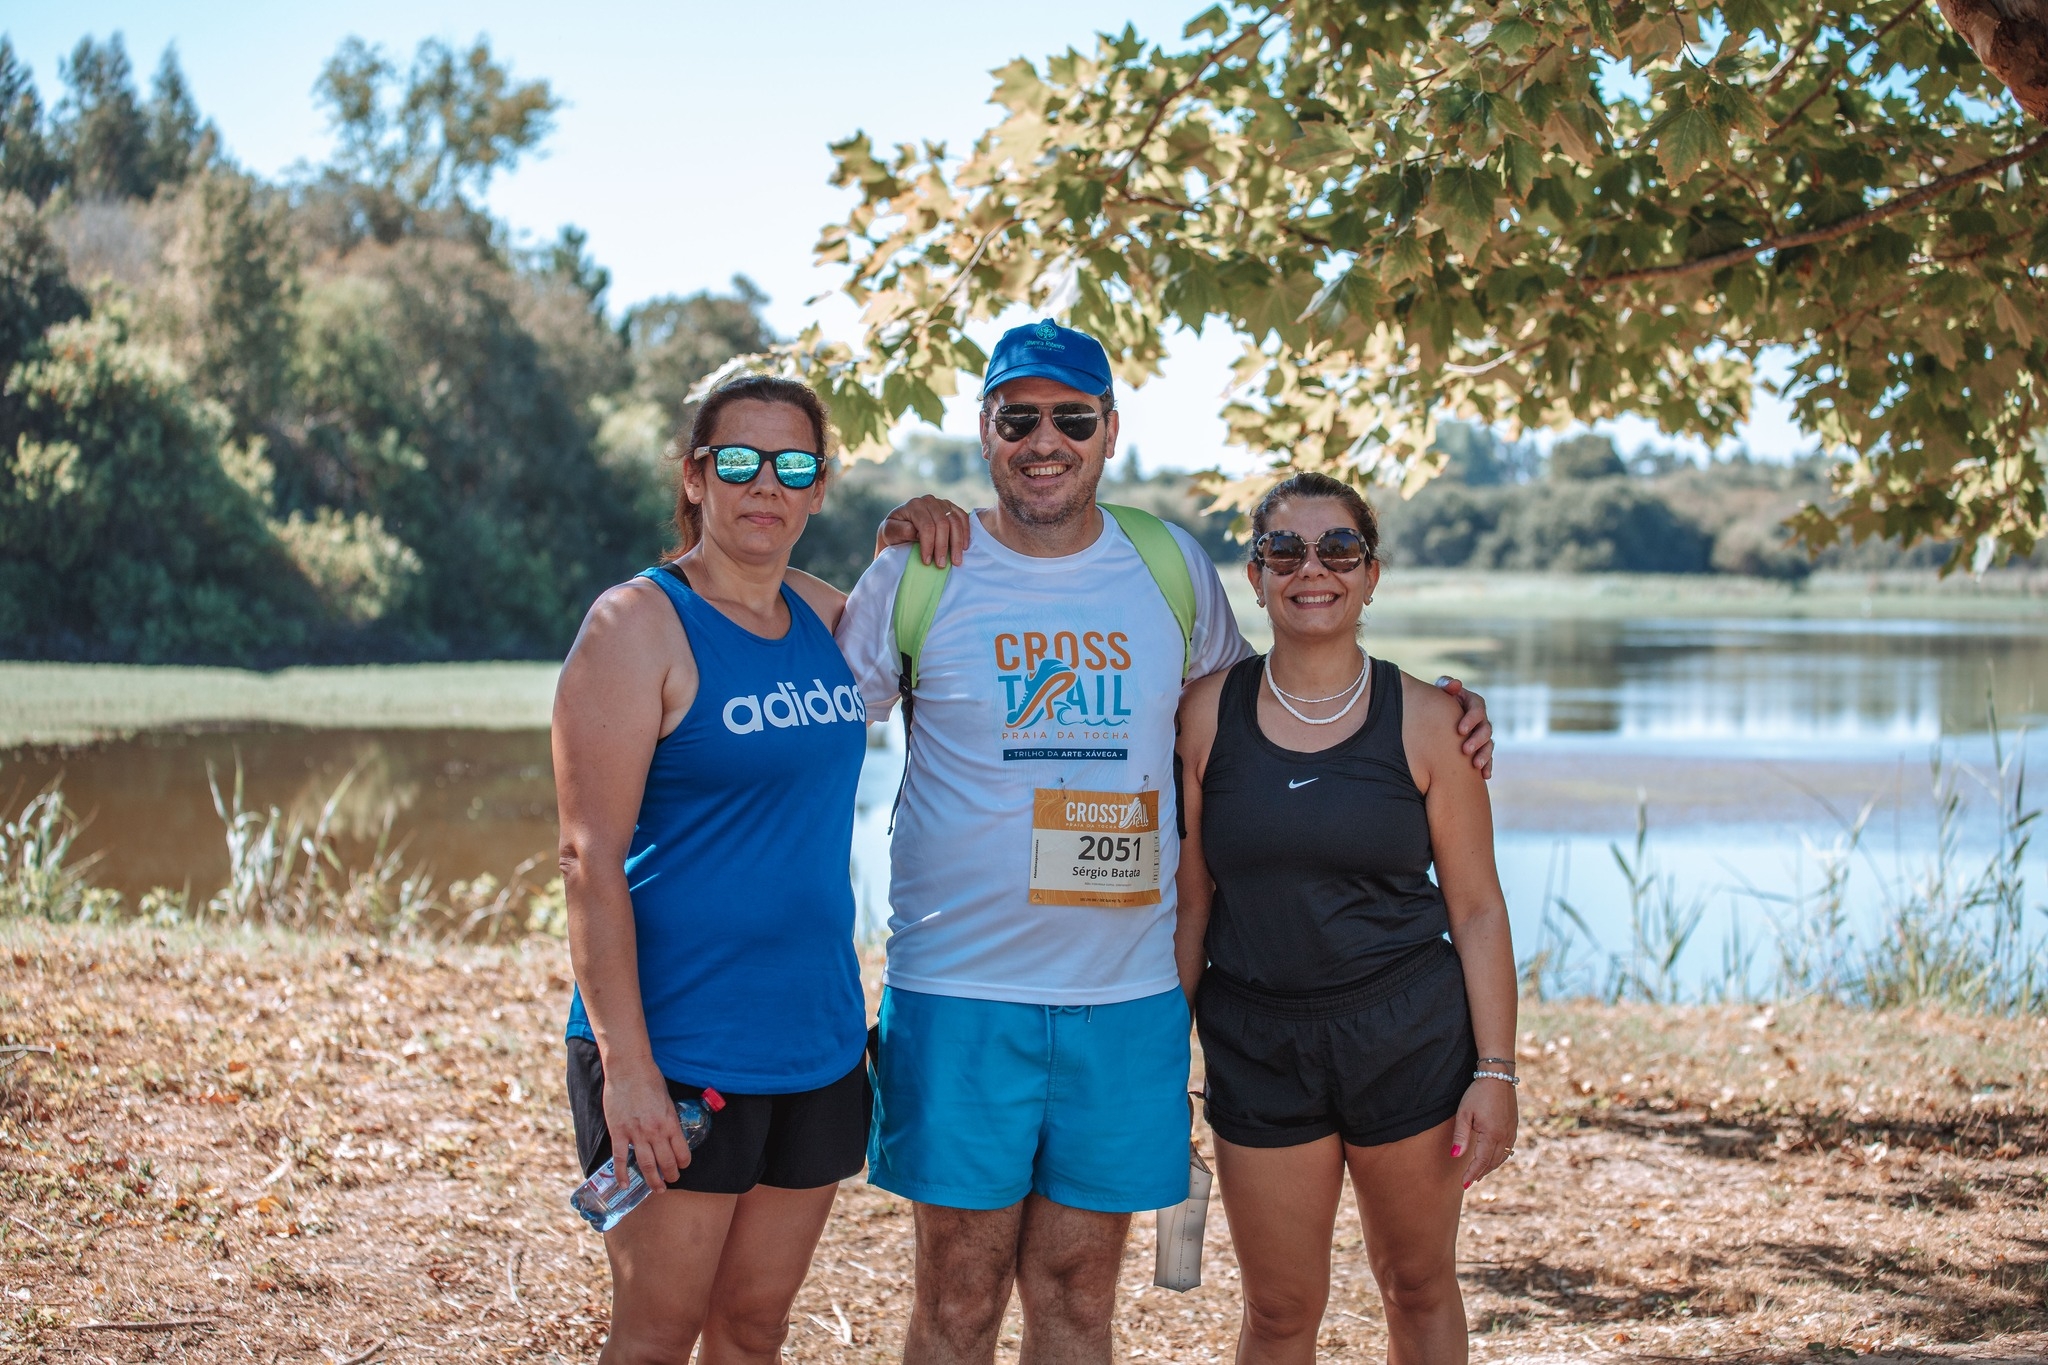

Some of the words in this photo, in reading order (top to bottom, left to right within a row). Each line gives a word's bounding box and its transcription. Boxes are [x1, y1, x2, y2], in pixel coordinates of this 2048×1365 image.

[994, 631, 1132, 671] CROSS
[722, 678, 866, 735] adidas
[1002, 731, 1047, 740] PRAIA
[1057, 731, 1075, 739] DA
[1083, 731, 1129, 740] TOCHA
[1014, 750, 1045, 758] TRILHO
[1061, 749, 1118, 758] ARTE-XÁVEGA
[1078, 835, 1141, 862] 2051
[1072, 866, 1108, 879] Sérgio
[1111, 868, 1141, 878] Batata
